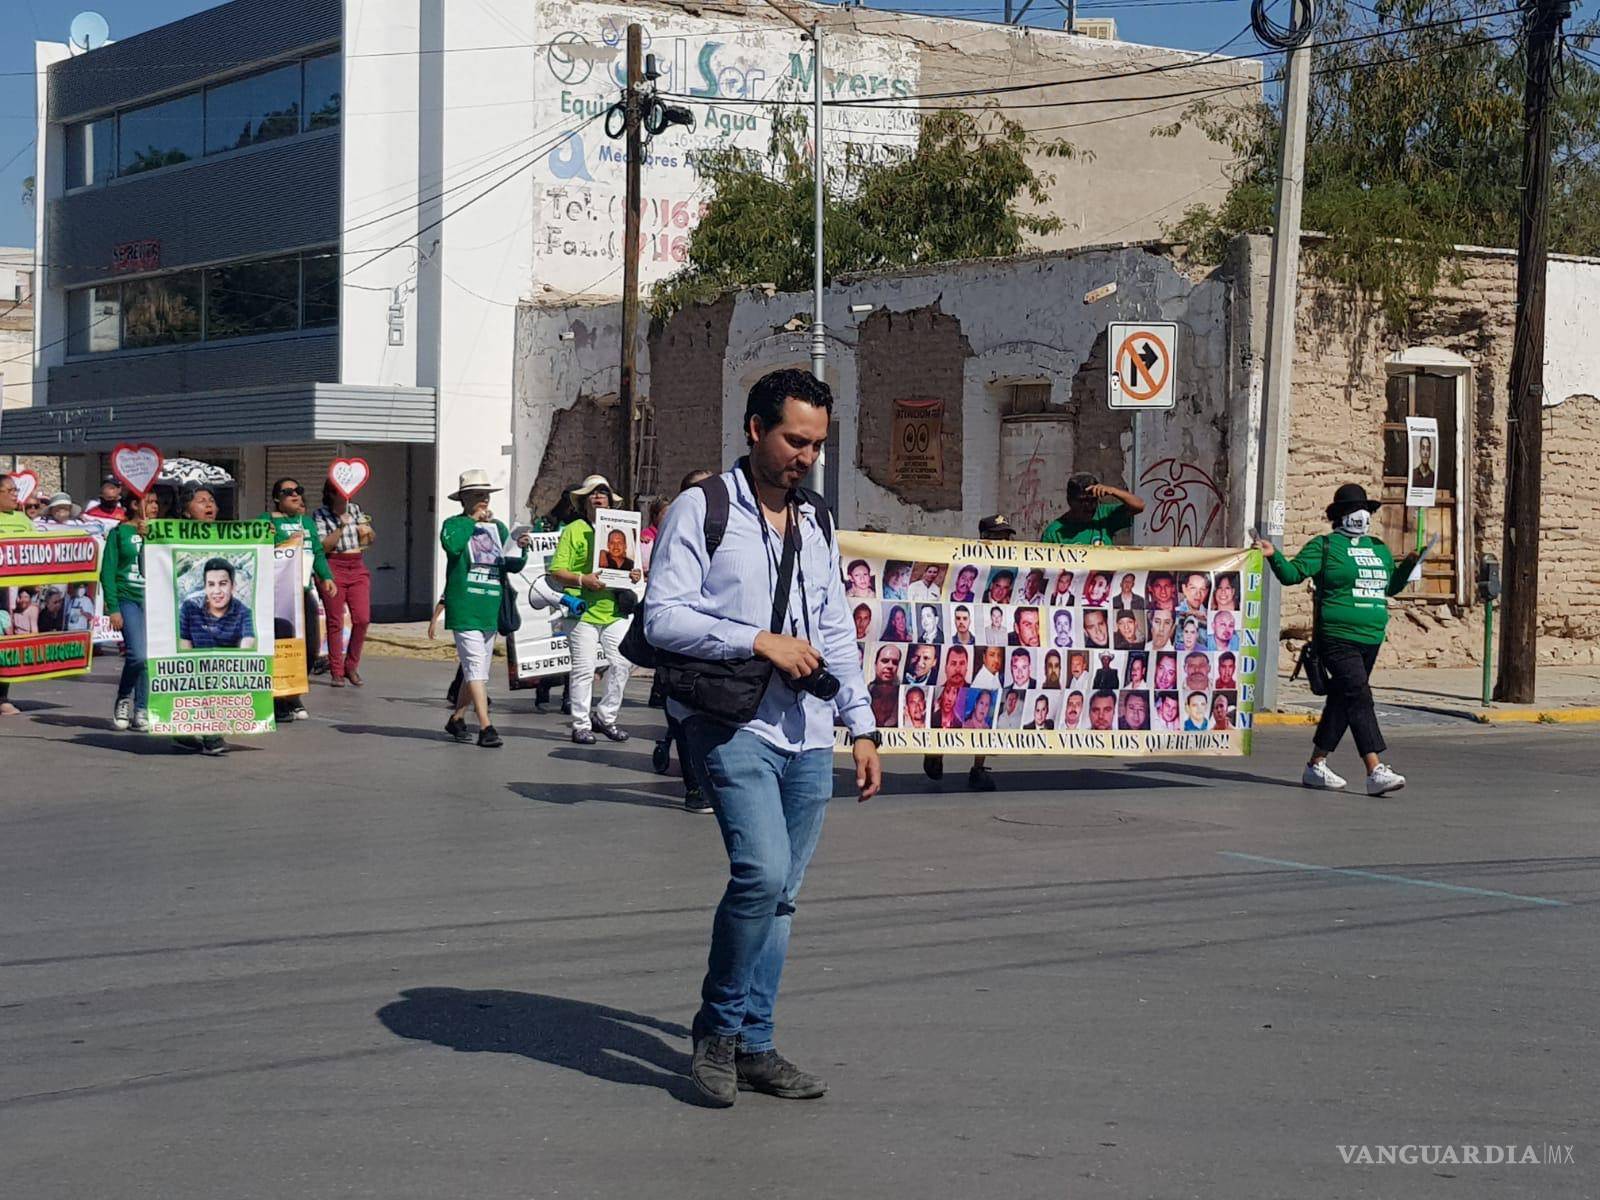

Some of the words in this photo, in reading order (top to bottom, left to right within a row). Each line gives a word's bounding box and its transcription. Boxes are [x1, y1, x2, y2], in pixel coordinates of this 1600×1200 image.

[704, 103, 757, 136] Agua
[179, 522, 211, 540] HAS
[216, 521, 271, 540] VISTO?
[7, 545, 17, 566] EL
[20, 543, 53, 565] ESTADO
[55, 541, 95, 564] MEXICANO
[157, 660, 194, 675] HUGO
[200, 658, 266, 673] MARCELINO
[521, 661, 533, 671] EL
[543, 658, 555, 668] DE
[222, 675, 272, 690] SALAZAR
[172, 710, 189, 721] 20
[226, 709, 254, 719] 2009
[912, 731, 931, 748] SE
[936, 731, 965, 748] LOS
[1058, 733, 1105, 749] VIVOS
[1111, 733, 1140, 750] LOS
